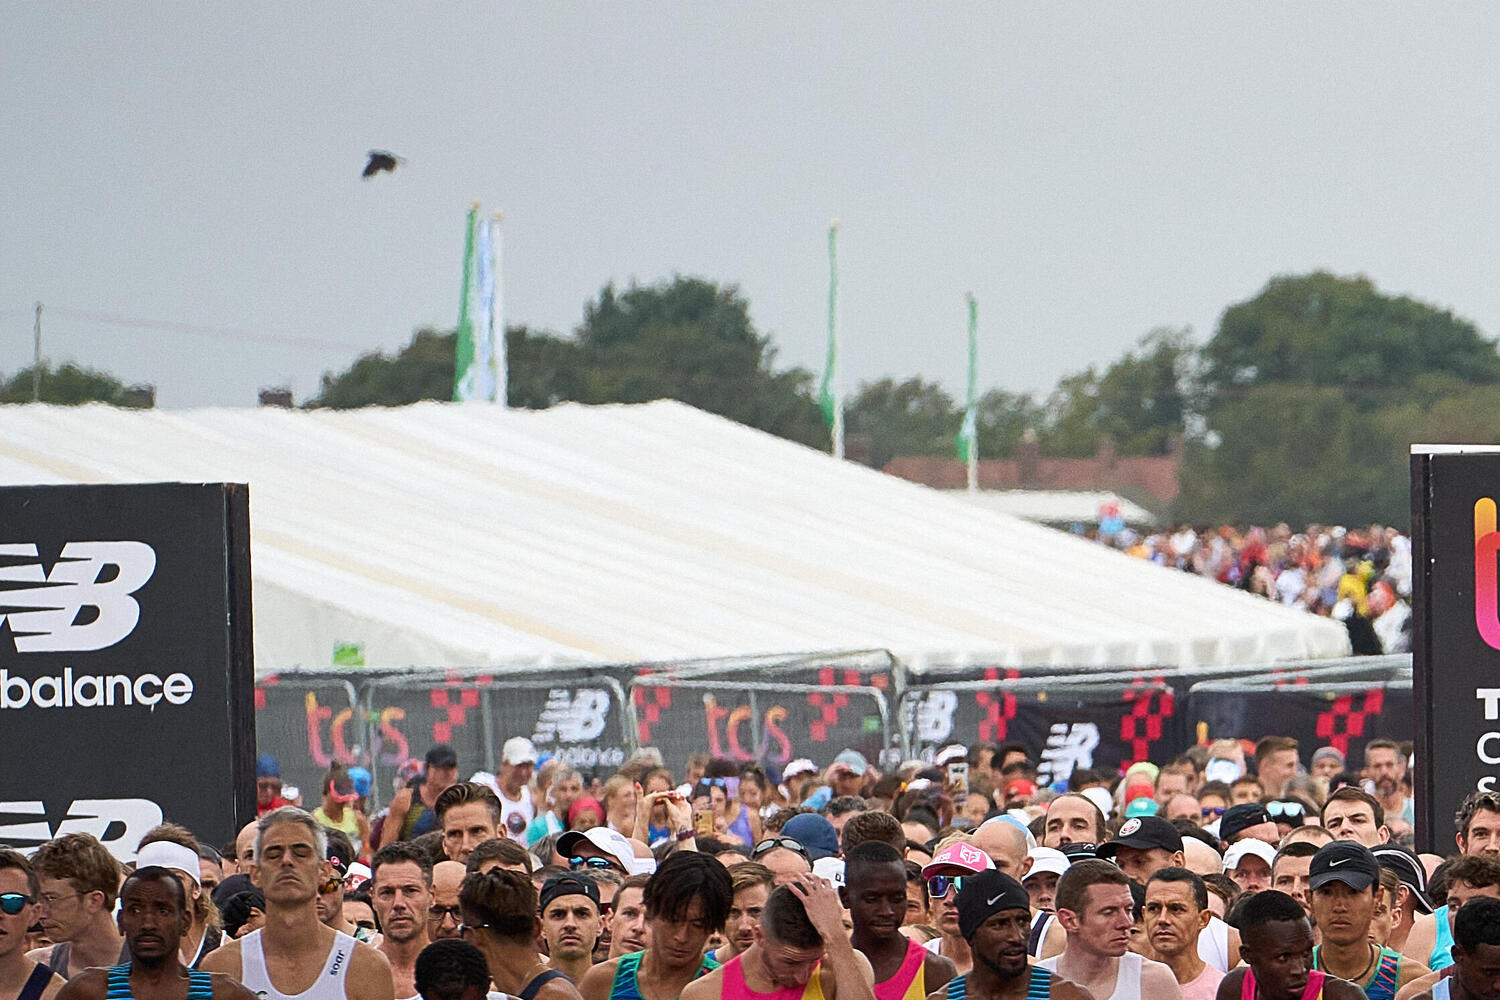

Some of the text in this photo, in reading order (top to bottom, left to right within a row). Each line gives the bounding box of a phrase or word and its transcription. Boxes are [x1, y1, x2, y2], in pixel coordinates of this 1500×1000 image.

[0, 667, 194, 712] balance
[703, 692, 792, 763] tcs
[330, 949, 345, 976] soar
